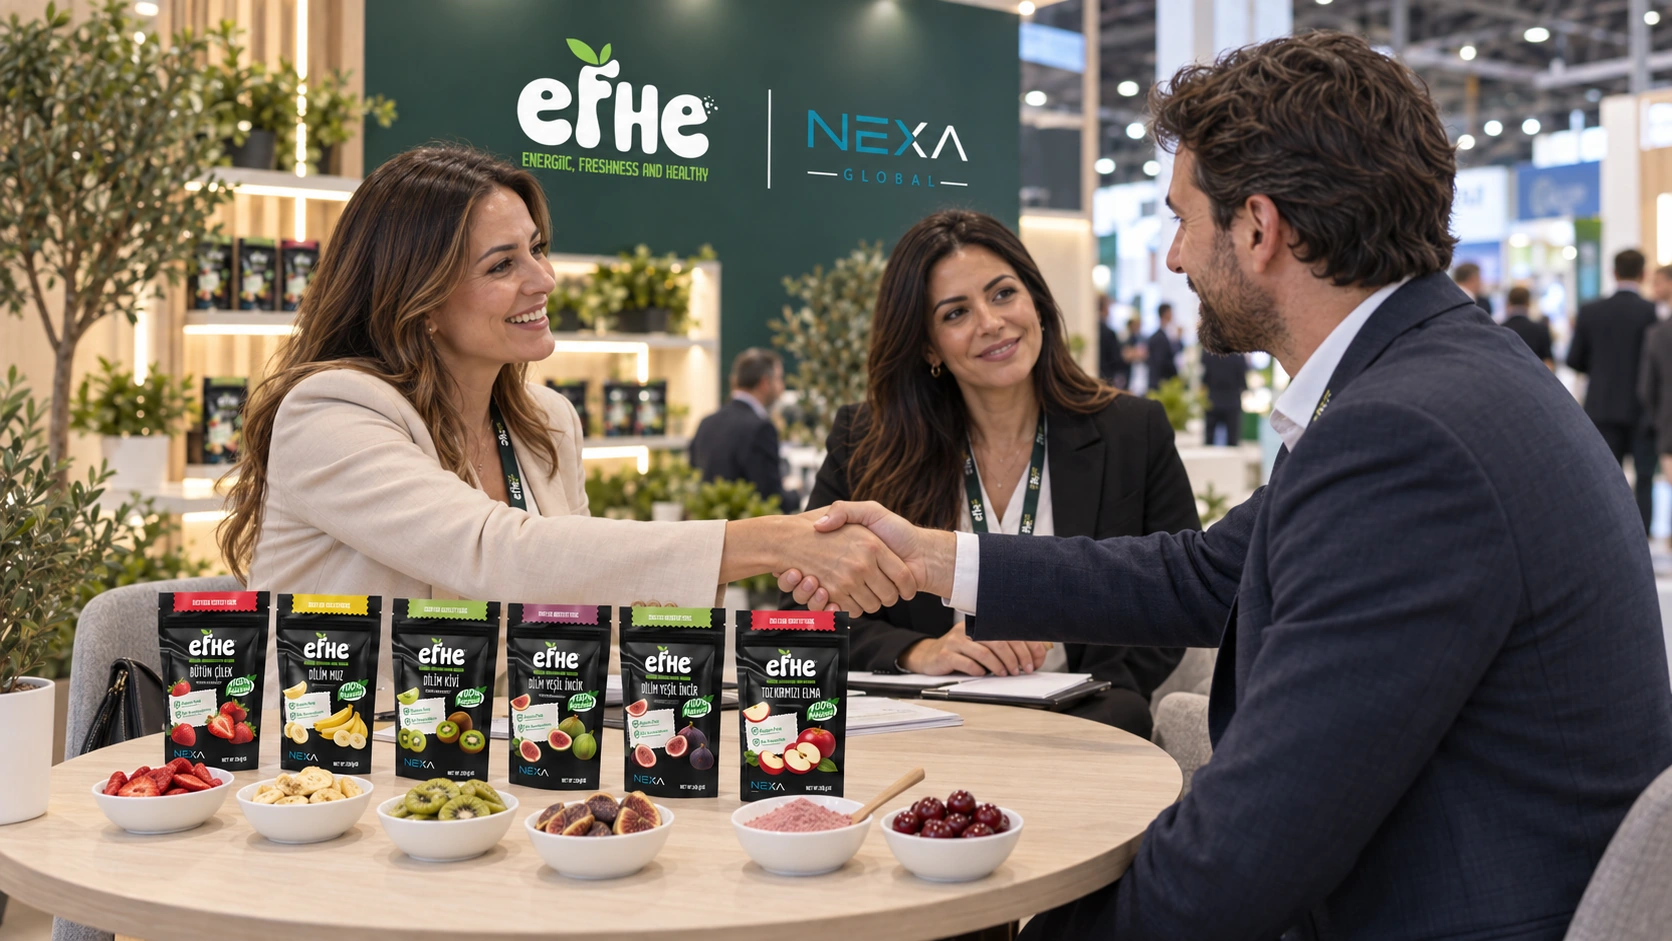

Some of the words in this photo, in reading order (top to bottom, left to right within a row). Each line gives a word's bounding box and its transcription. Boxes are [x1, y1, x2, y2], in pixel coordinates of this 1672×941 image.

[807, 109, 969, 162] NEXA
[578, 157, 639, 177] FRESHNESS
[642, 162, 663, 178] AND
[665, 164, 709, 182] HEALTHY
[843, 168, 935, 188] GLOBAL
[174, 749, 206, 760] NEXA
[288, 751, 319, 763] NEXA
[403, 757, 435, 770] NEXA
[518, 765, 549, 777] NEXA
[633, 774, 665, 786] NEXA
[751, 780, 785, 791] NEXA
